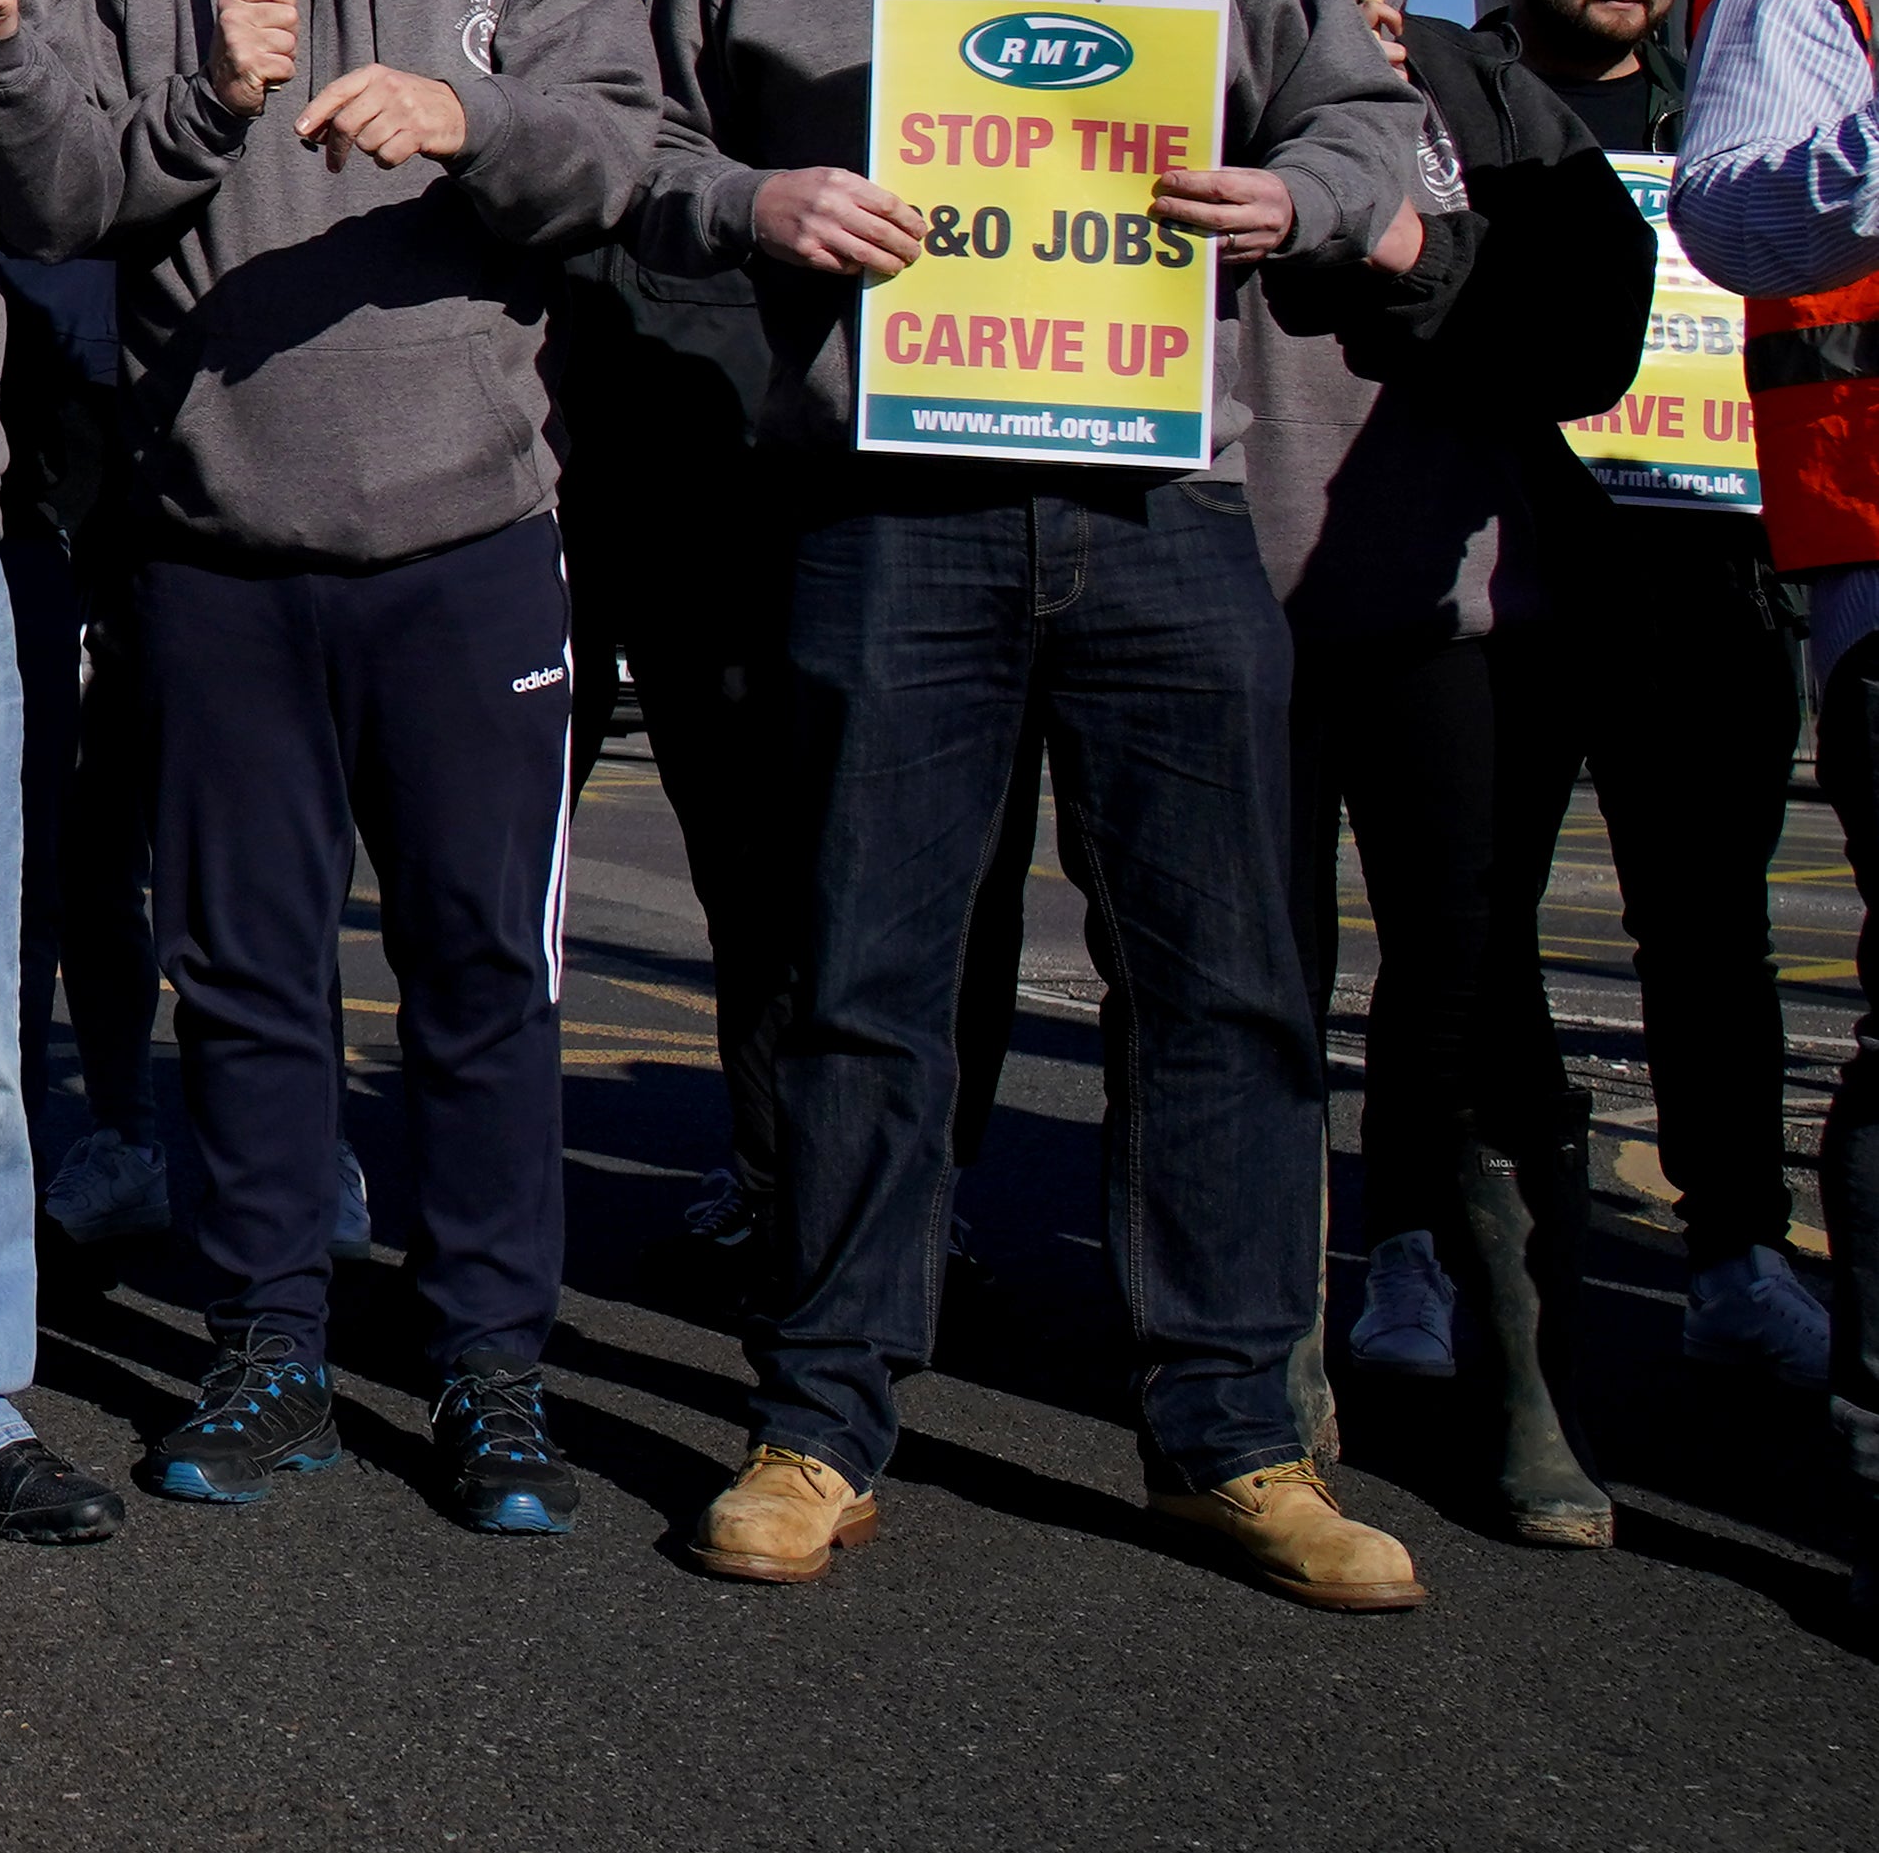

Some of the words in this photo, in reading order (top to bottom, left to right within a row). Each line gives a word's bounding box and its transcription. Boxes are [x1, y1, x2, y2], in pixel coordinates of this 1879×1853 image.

[996, 37, 1101, 68] RMT
[899, 112, 1054, 169] STOP
[1072, 119, 1189, 175] THE
[908, 204, 1011, 260] &O
[1032, 210, 1195, 269] JOBS
[884, 311, 1085, 374] CARVE
[1107, 322, 1190, 379] UP
[912, 408, 1156, 446] www.rmt.org.uk
[1560, 394, 1685, 439] RVE
[1591, 465, 1745, 496] w.rmt.org.uk
[512, 666, 564, 693] adidas
